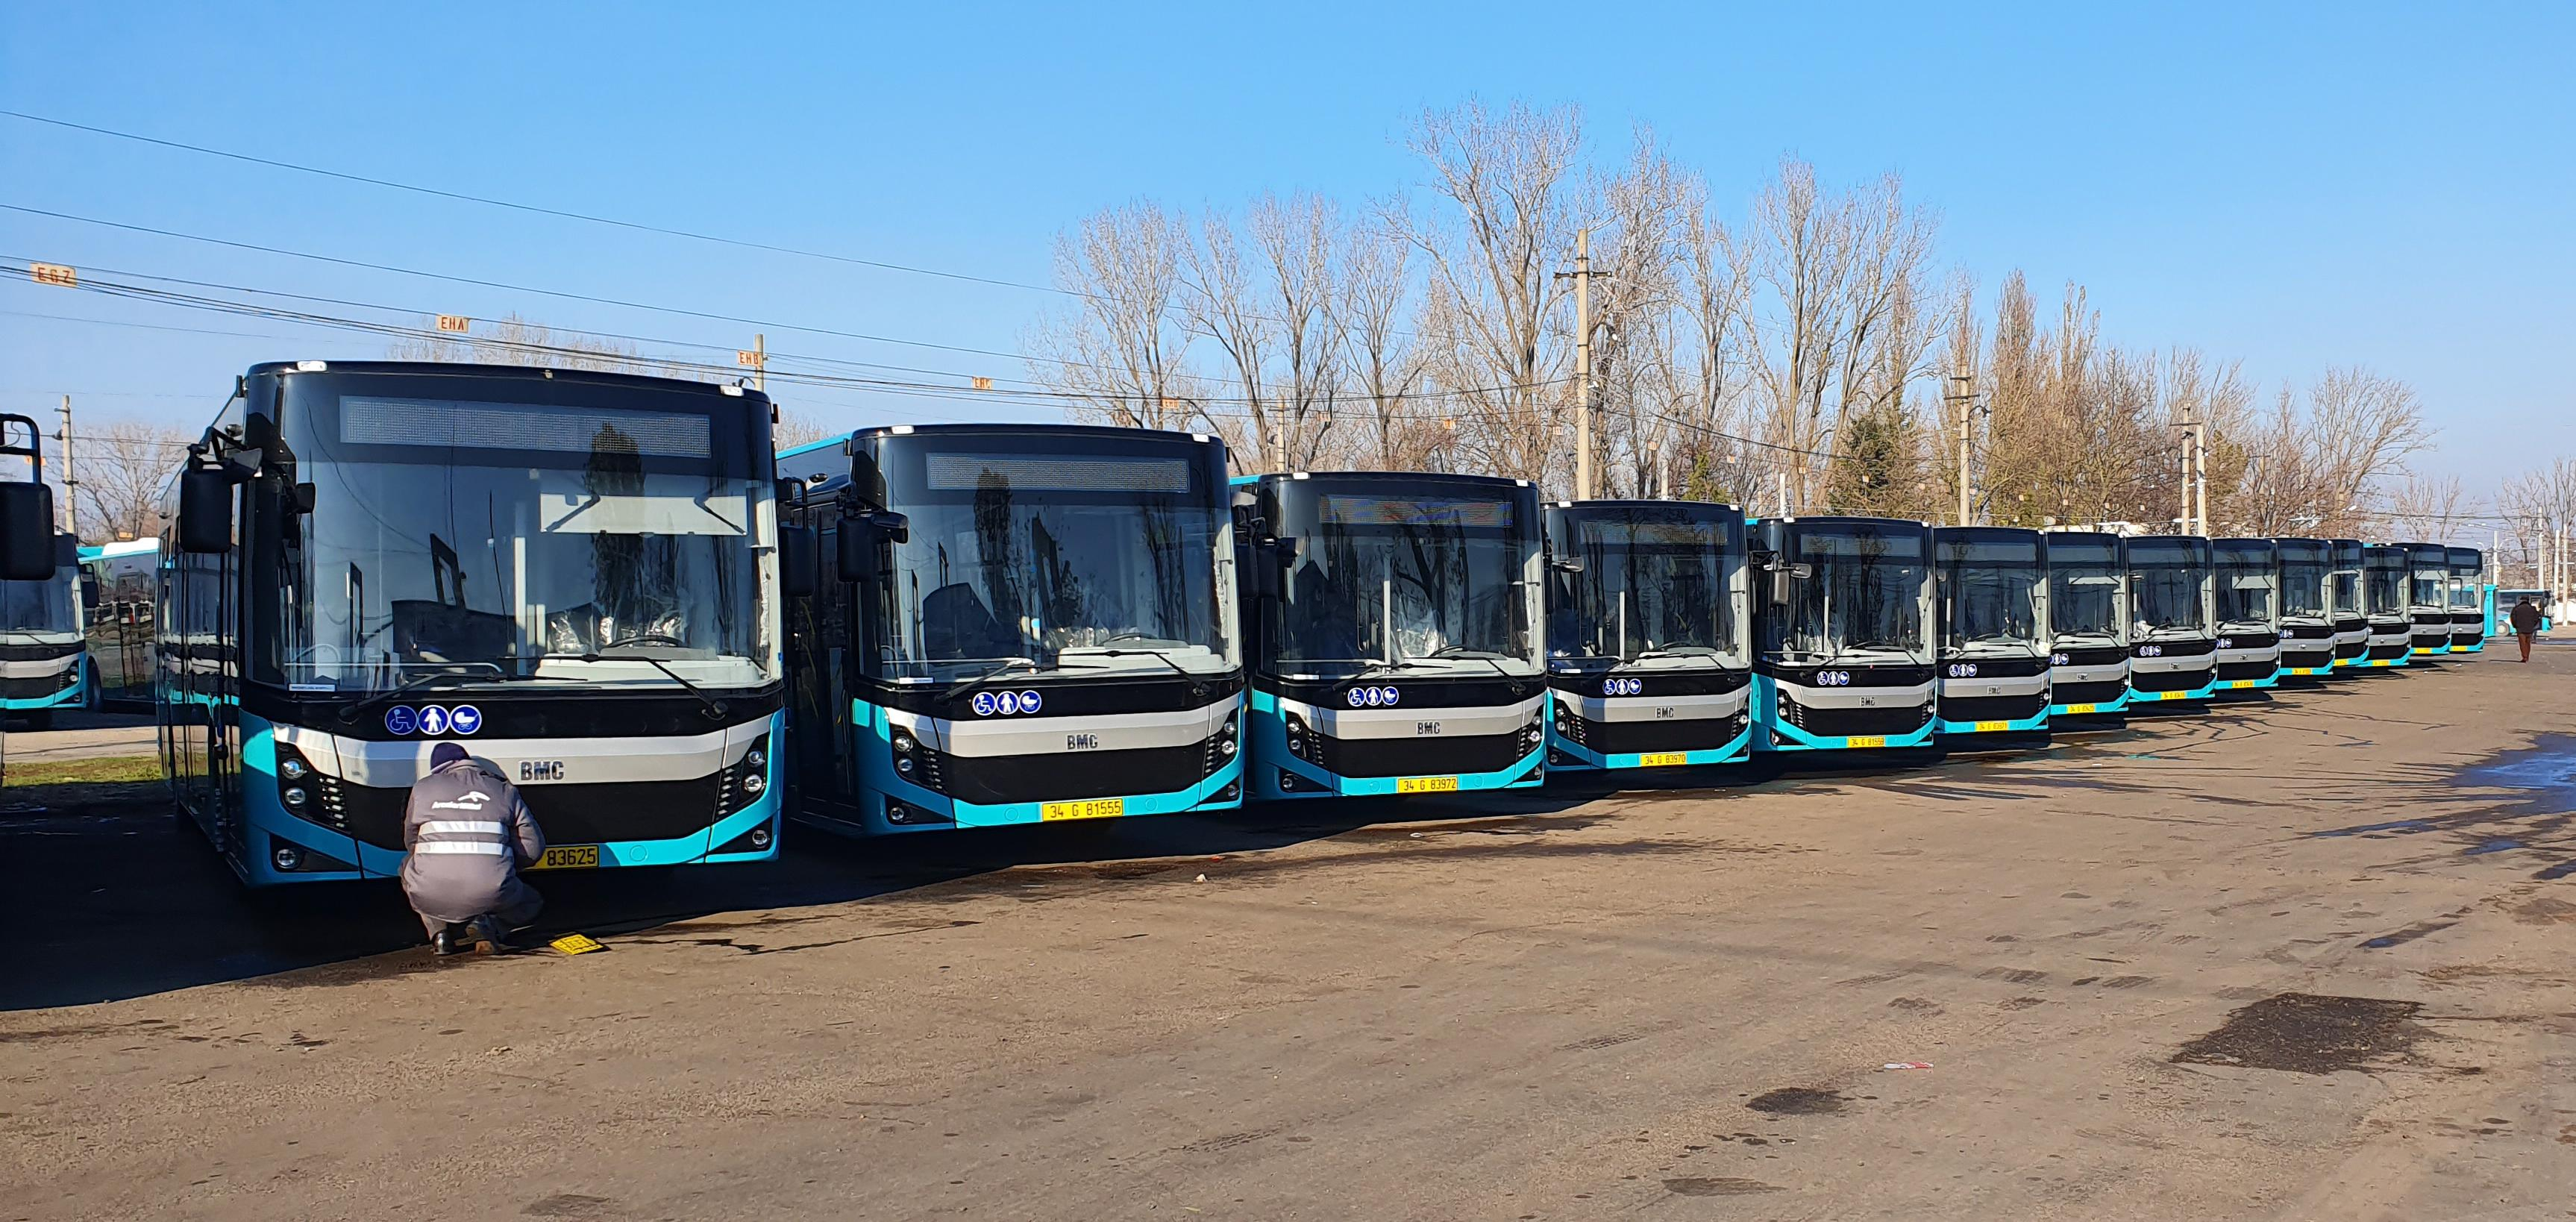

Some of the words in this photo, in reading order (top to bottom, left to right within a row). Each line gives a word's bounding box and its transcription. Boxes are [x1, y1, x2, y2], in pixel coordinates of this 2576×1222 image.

[441, 316, 465, 330] EHA
[739, 352, 759, 365] EHB
[1656, 706, 1674, 718] BMC
[1417, 721, 1441, 735] BMC
[1067, 734, 1098, 751] BMC
[1645, 755, 1653, 765] 34
[520, 761, 565, 781] BMC
[1403, 780, 1414, 792] 34
[1420, 780, 1426, 791] G
[1430, 777, 1457, 790] 83972
[1050, 804, 1064, 818] 34
[1071, 803, 1079, 817] G
[1086, 800, 1121, 816] 81555
[547, 847, 596, 866] 83625
